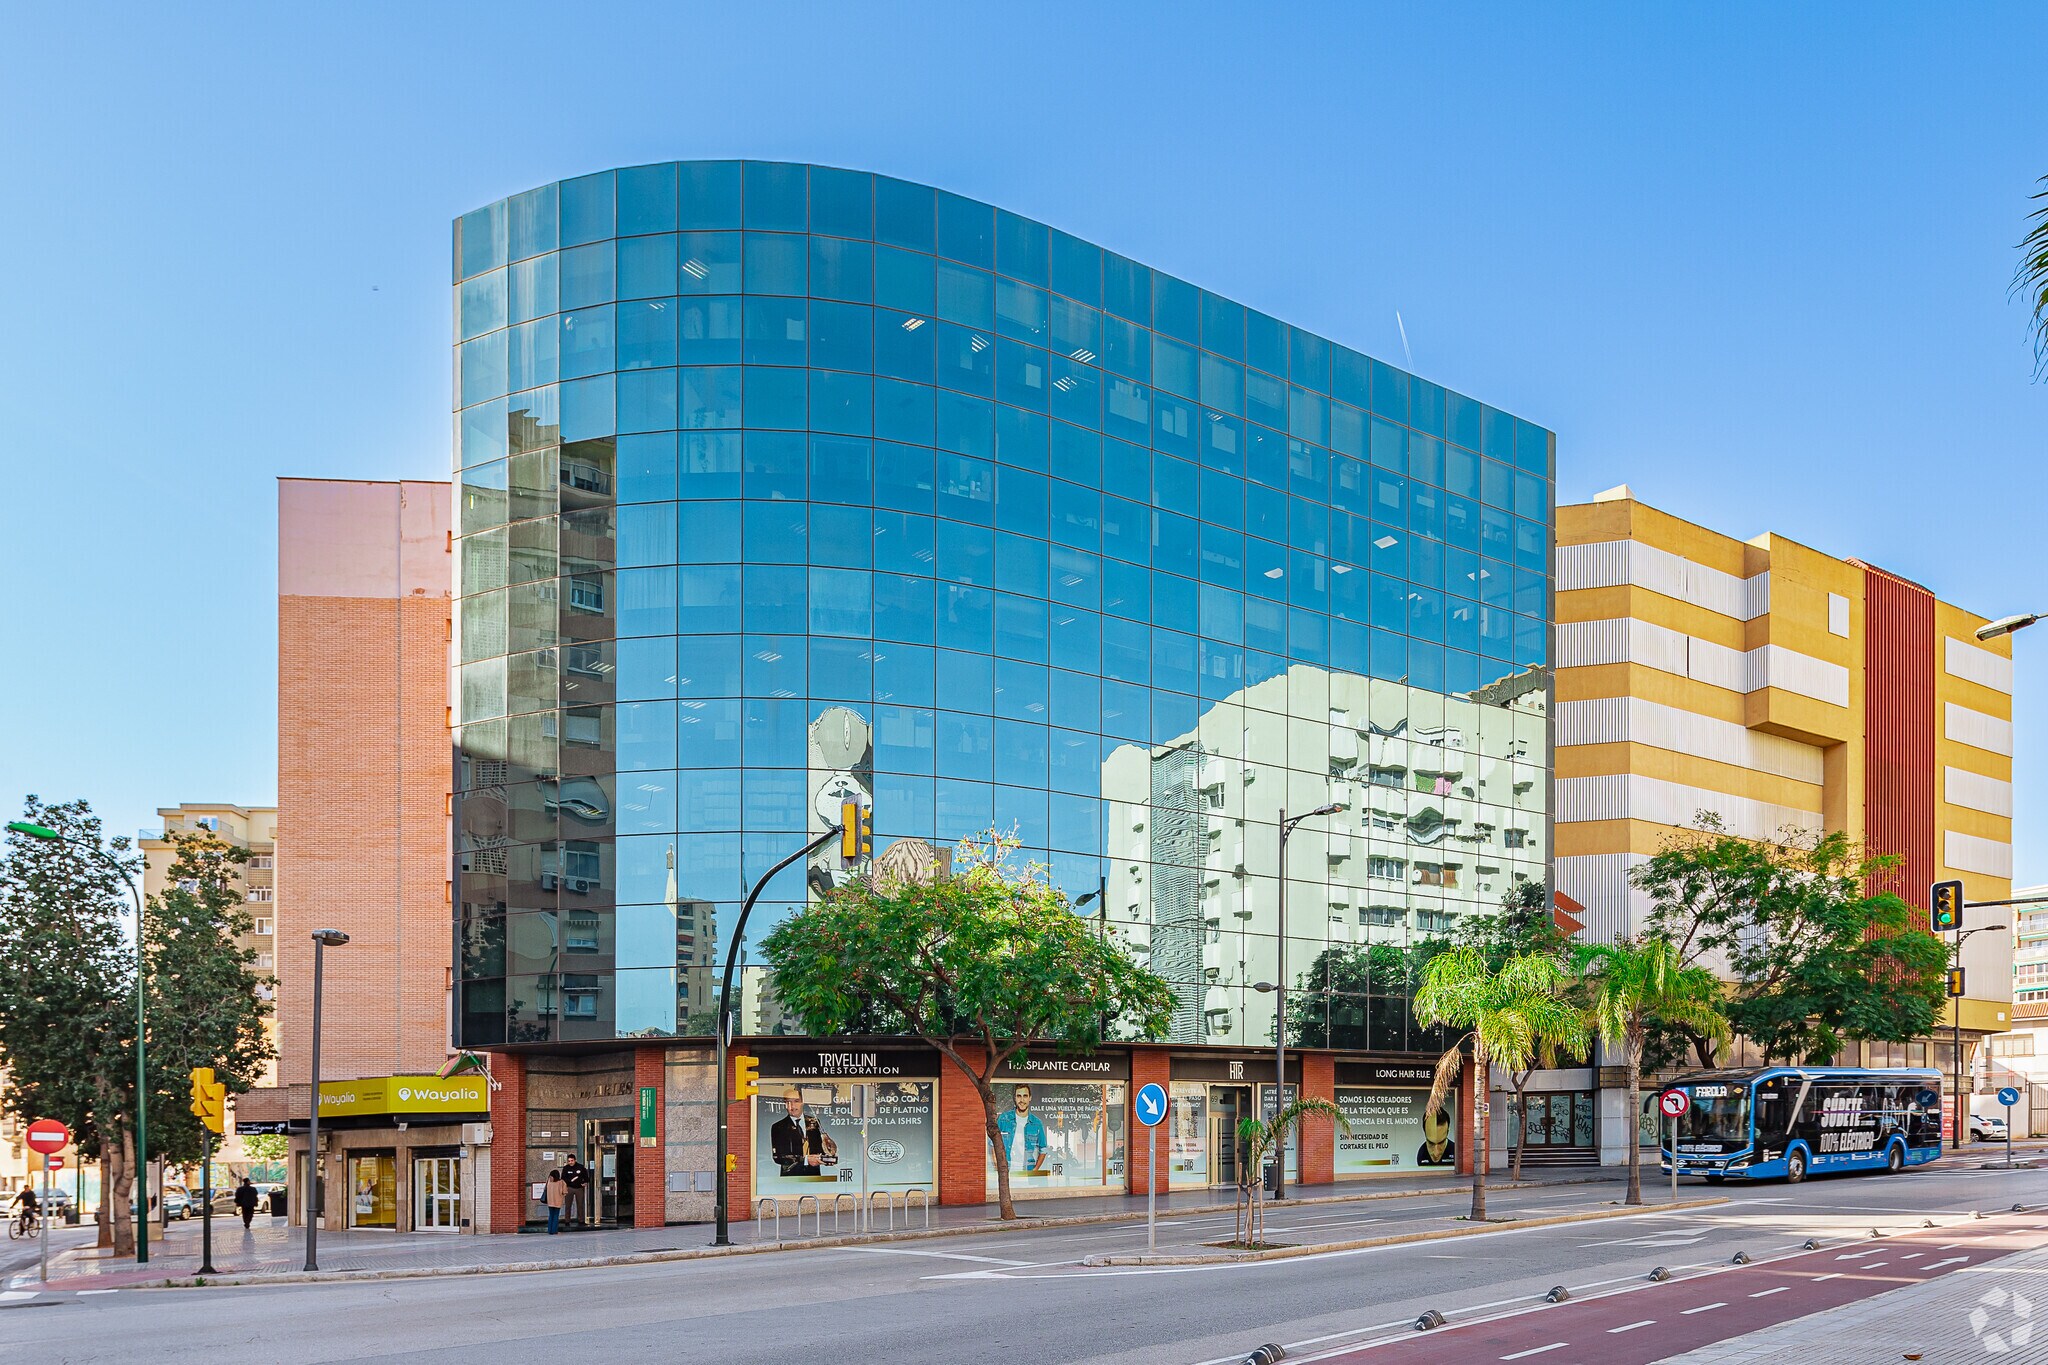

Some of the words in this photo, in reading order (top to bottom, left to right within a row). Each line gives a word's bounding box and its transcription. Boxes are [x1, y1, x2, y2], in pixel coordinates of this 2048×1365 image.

[818, 1053, 877, 1067] TRIVELLINI
[792, 1066, 818, 1075] HAIR
[823, 1066, 900, 1075] RESTORATION
[1007, 1061, 1068, 1071] TSPLANTE
[1071, 1061, 1110, 1072] CAPILAR
[1229, 1061, 1244, 1080] HTR
[1375, 1069, 1398, 1078] LONG
[1398, 1070, 1415, 1078] HAIR
[413, 1087, 479, 1102] Wayalia
[1695, 1086, 1728, 1097] FAROLA
[324, 1091, 356, 1106] Wayalia
[900, 1095, 920, 1104] CON
[1339, 1095, 1362, 1104] SOMOS
[1363, 1095, 1375, 1103] LOS
[1376, 1095, 1412, 1104] CREADORES
[823, 1107, 834, 1115] EL
[880, 1106, 891, 1114] DE
[892, 1106, 929, 1114] PLATINO
[1340, 1107, 1348, 1115] DE
[1349, 1107, 1358, 1115] LA
[1359, 1105, 1386, 1115] TÉCNICA
[1387, 1107, 1400, 1116] QUE
[1401, 1107, 1409, 1115] ES
[1820, 1092, 1864, 1128] SÚBETE
[830, 1118, 863, 1126] 2021-22
[885, 1117, 896, 1125] LA
[898, 1117, 922, 1125] ISHRS
[1819, 1132, 1840, 1153] 100%
[1839, 1129, 1875, 1152] ELÉCTRICO
[839, 1168, 853, 1182] HTR
[1052, 1163, 1063, 1176] HTR
